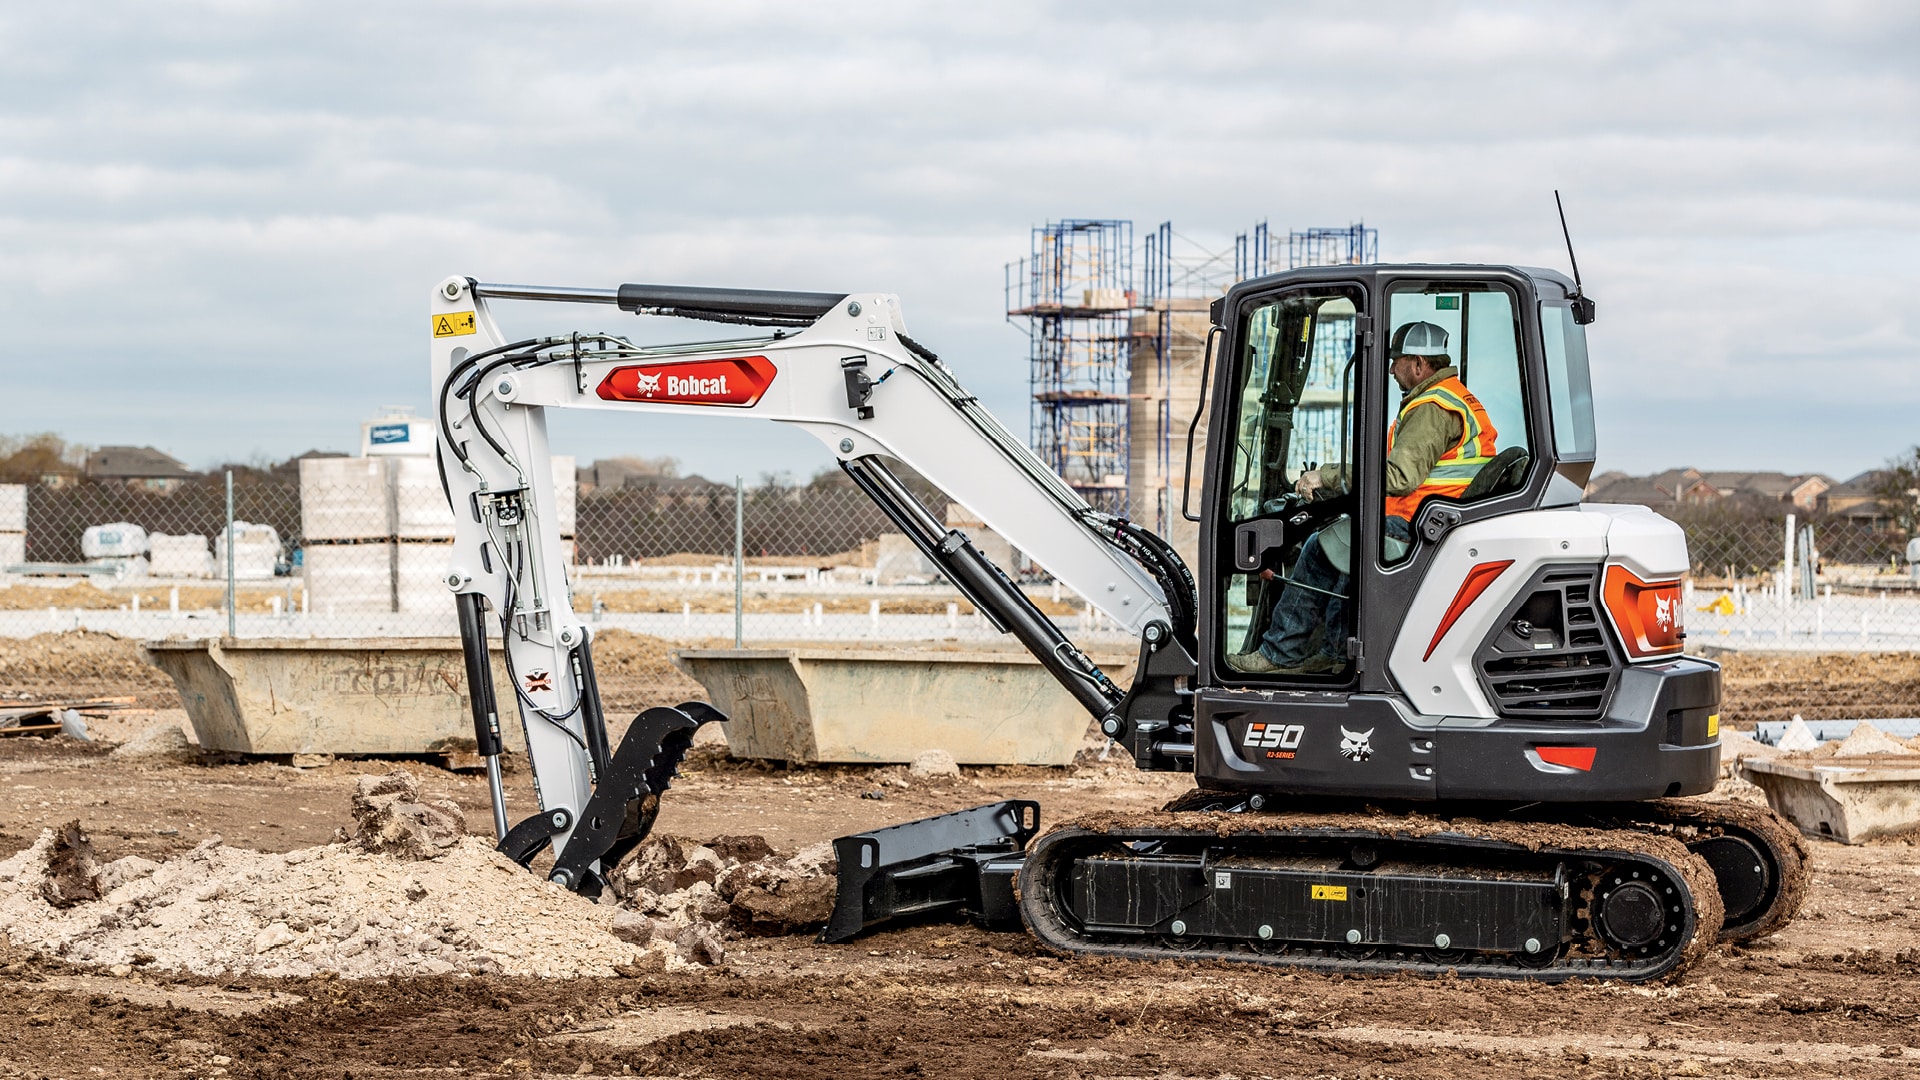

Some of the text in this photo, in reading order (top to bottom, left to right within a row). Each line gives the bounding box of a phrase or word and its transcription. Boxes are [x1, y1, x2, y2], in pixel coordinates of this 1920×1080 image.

[667, 374, 728, 396] Bobcat
[1243, 722, 1305, 749] E50
[1266, 751, 1295, 759] R2-SERIES
